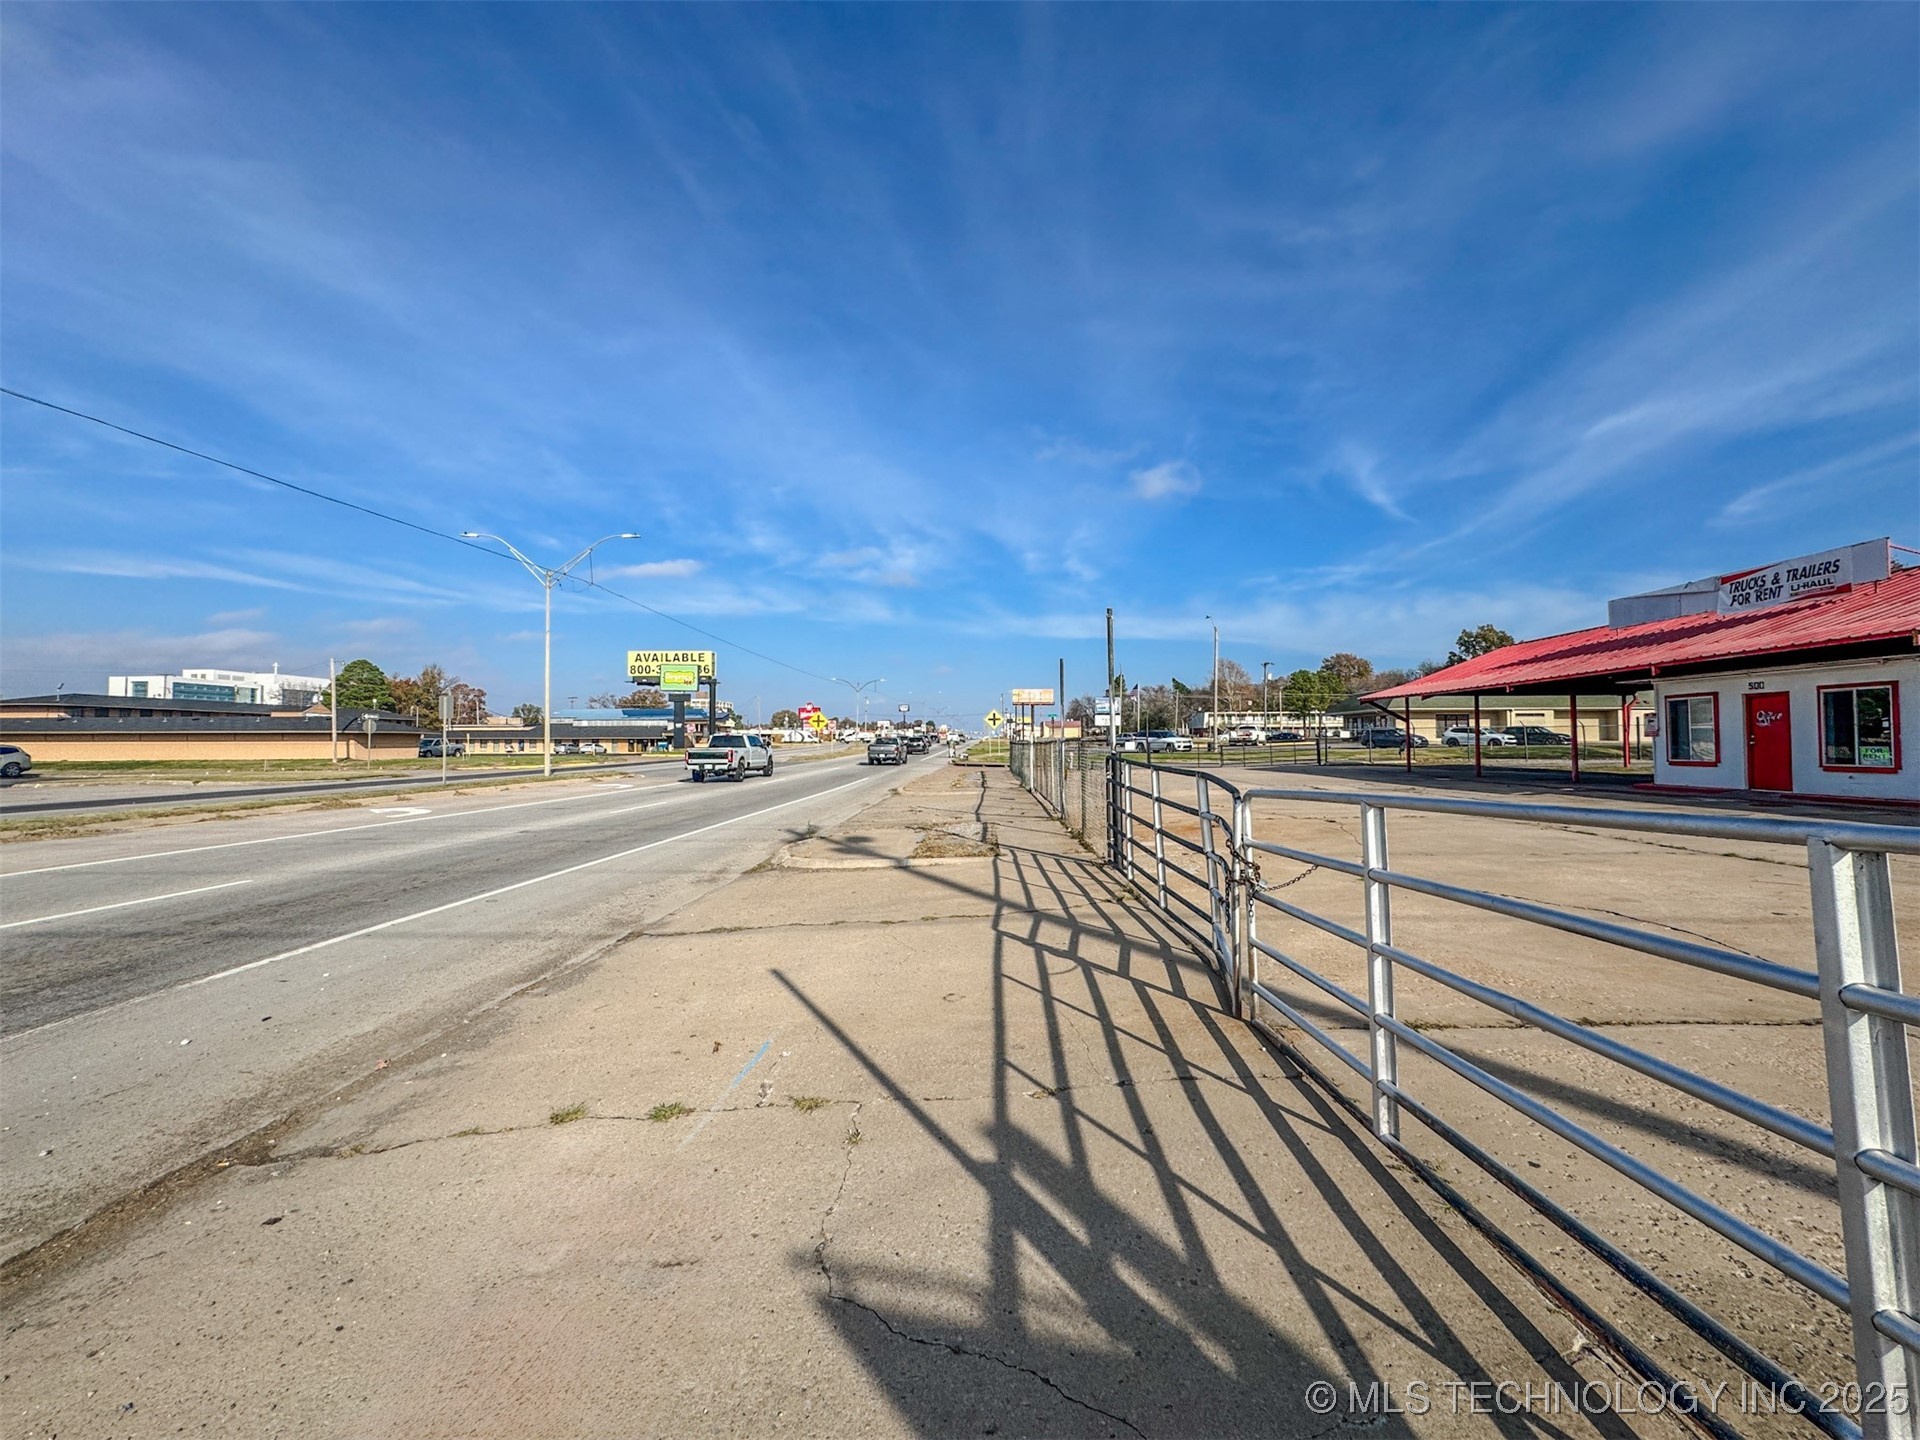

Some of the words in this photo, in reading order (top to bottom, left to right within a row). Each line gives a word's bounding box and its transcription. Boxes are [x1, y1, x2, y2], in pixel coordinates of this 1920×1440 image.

[1729, 574, 1766, 595] TRUCKS
[1771, 571, 1780, 586] &
[1786, 559, 1841, 583] TRAILERS
[1790, 577, 1834, 592] U-HAUL
[1730, 592, 1751, 607] FOR
[1755, 585, 1784, 602] RENT
[634, 652, 705, 662] AVAILABLE
[1748, 681, 1765, 690] 500
